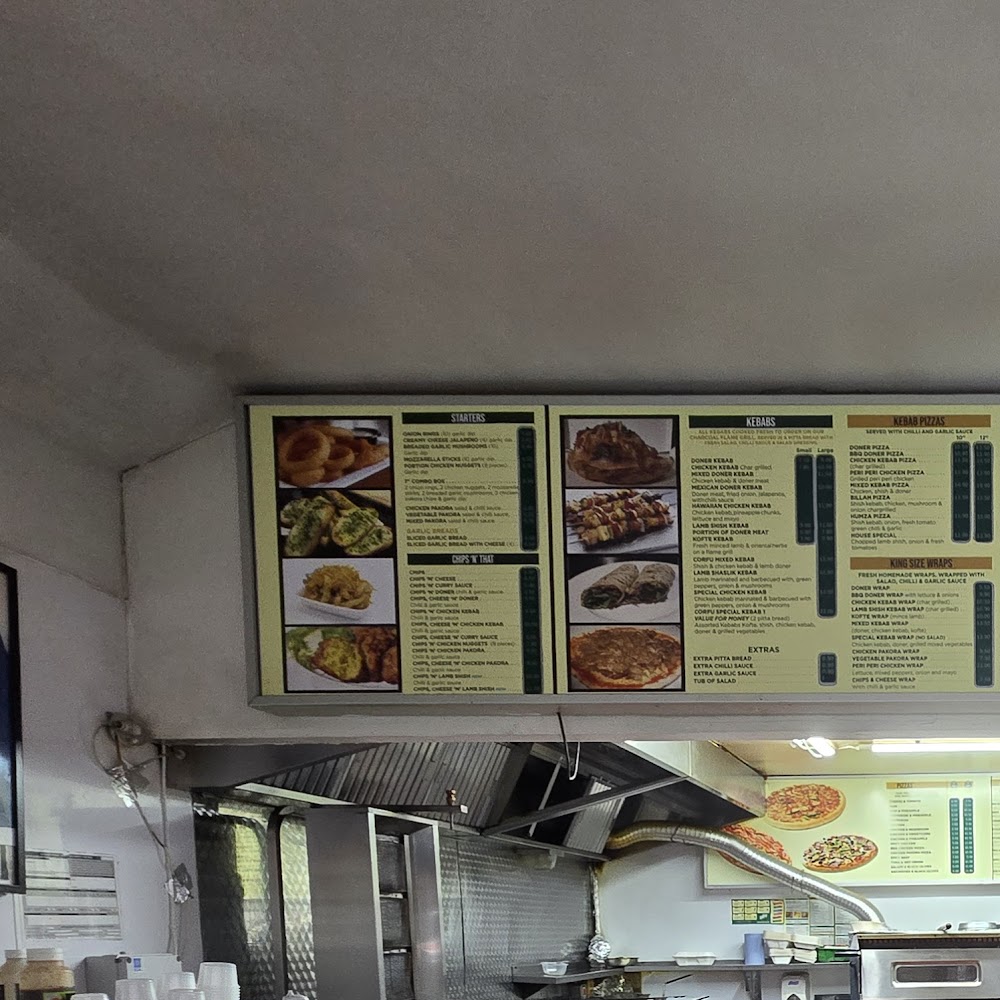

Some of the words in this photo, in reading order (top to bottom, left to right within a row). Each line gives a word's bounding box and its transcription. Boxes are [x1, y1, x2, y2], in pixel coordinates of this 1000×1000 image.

[451, 414, 486, 422] STARTERS
[746, 417, 776, 427] KEBABS
[894, 416, 918, 426] KEBAB
[920, 416, 945, 426] PIZZAS
[452, 555, 470, 563] CHIPS
[480, 555, 494, 563] THAT
[890, 559, 907, 568] KING
[909, 559, 925, 568] SIZE
[927, 559, 953, 568] WRAPS
